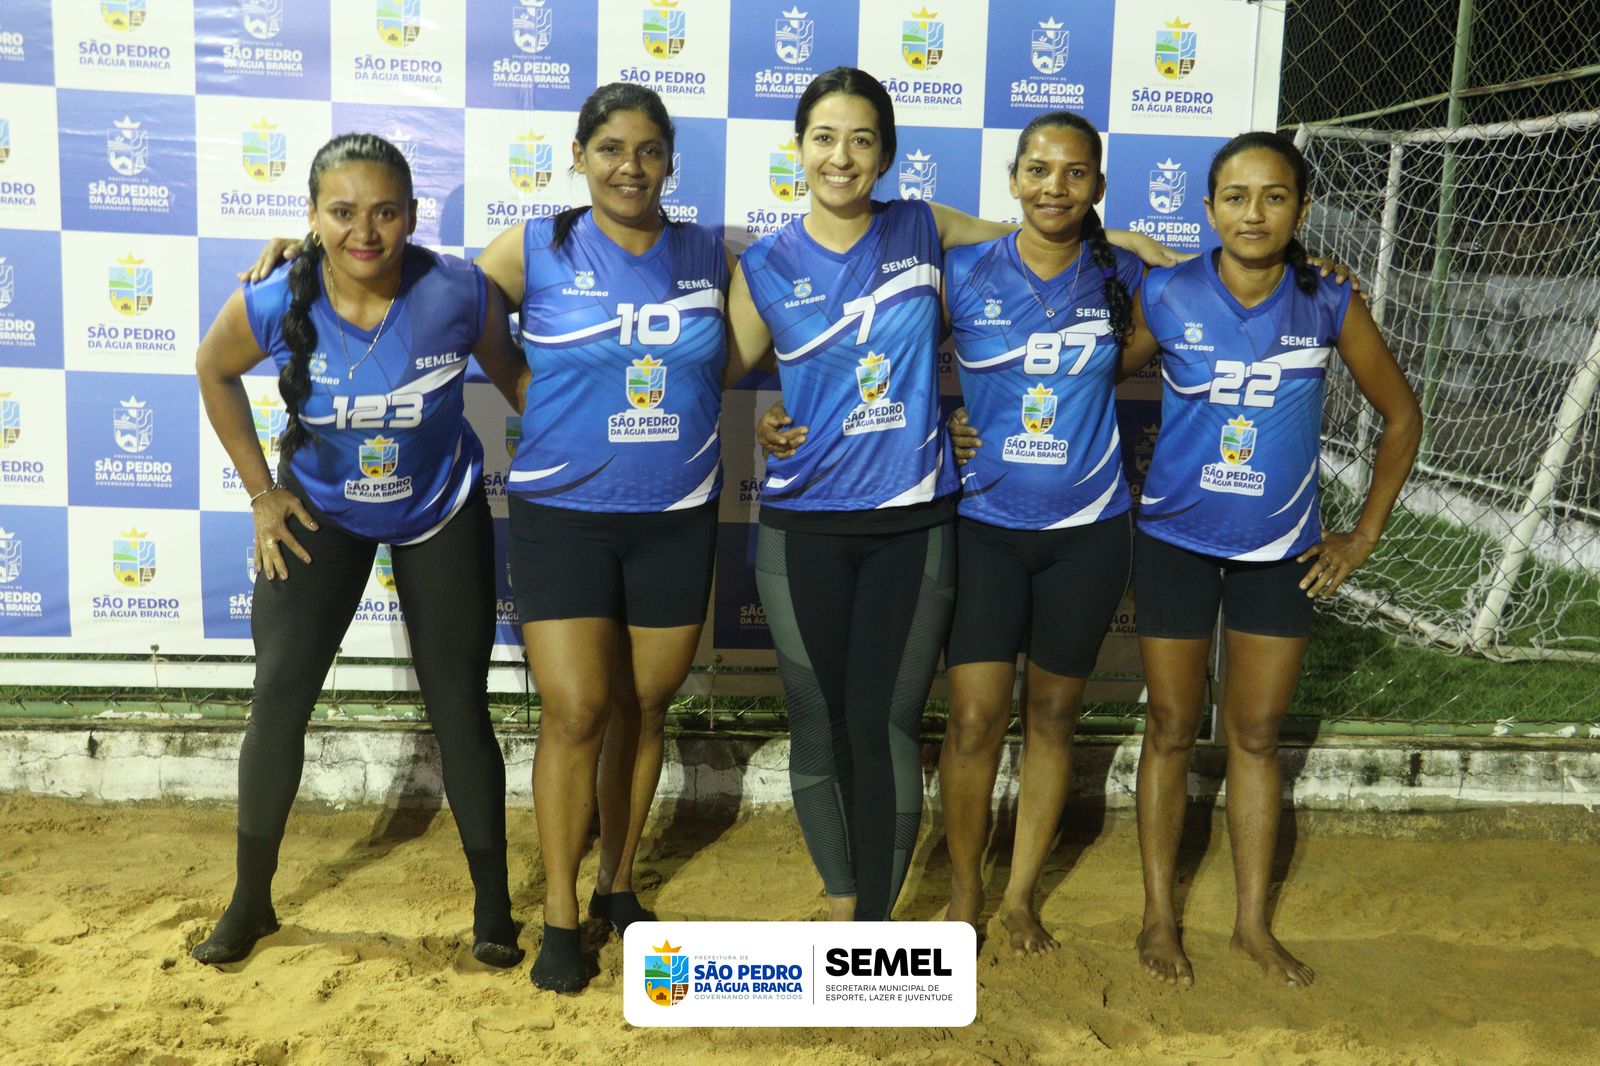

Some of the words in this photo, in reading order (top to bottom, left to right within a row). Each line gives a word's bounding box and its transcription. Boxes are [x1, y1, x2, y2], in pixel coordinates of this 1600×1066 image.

[79, 40, 110, 55] SÃO
[117, 44, 170, 59] PEDRO
[223, 44, 251, 60] SÃO
[255, 49, 303, 62] PEDRO
[80, 56, 94, 65] DA
[97, 56, 126, 67] ÁGUA
[129, 60, 171, 70] BRANCA
[240, 60, 264, 70] ÁGUA
[267, 62, 303, 72] BRANCA
[355, 54, 385, 70] SÃO
[390, 59, 442, 73] PEDRO
[493, 58, 521, 73] SÃO
[527, 63, 570, 75] PEDRO
[355, 72, 368, 81] DA
[372, 71, 399, 82] ÁGUA
[402, 74, 442, 84] BRANCA
[493, 74, 507, 82] DA
[509, 73, 532, 83] ÁGUA
[534, 74, 570, 84] BRANCA
[621, 67, 650, 82] SÃO
[655, 71, 705, 84] PEDRO
[755, 69, 783, 83] SÃO
[667, 85, 705, 94] BRANCA
[755, 84, 768, 92] DA
[770, 83, 793, 93] ÁGUA
[913, 81, 962, 94] PEDRO
[1011, 80, 1039, 94] SÃO
[1043, 82, 1084, 96] PEDRO
[895, 93, 921, 103] ÁGUA
[924, 96, 962, 104] BRANCA
[1025, 94, 1048, 103] ÁGUA
[1050, 96, 1083, 104] BRANCA
[1132, 87, 1161, 102] SÃO
[1165, 91, 1213, 104] PEDRO
[1147, 102, 1172, 112] ÁGUA
[1176, 105, 1212, 113] BRANCA
[89, 180, 118, 196] SÃO
[122, 185, 168, 198] PEDRO
[89, 196, 102, 204] DA
[105, 195, 130, 206] ÁGUA
[132, 197, 168, 207] BRANCA
[221, 189, 252, 205] SÃO
[257, 193, 307, 207] PEDRO
[221, 207, 235, 216] DA
[238, 205, 266, 216] ÁGUA
[269, 208, 308, 218] BRANCA
[488, 201, 517, 216] SÃO
[748, 209, 777, 223] SÃO
[1129, 219, 1155, 232] SÃO
[1158, 222, 1200, 234] PEDRO
[881, 256, 919, 274] SEMEL
[677, 278, 713, 289] SEMEL
[785, 300, 799, 309] SÃO
[801, 294, 826, 305] PEDRO
[616, 303, 681, 345] 10
[843, 294, 876, 346] 7
[974, 318, 987, 326] SÃO
[88, 323, 119, 339] SÃO
[124, 328, 176, 341] PEDRO
[88, 340, 102, 349] DA
[105, 339, 133, 350] ÁGUA
[136, 342, 176, 351] BRANCA
[1280, 335, 1320, 347] SEMEL
[1023, 332, 1096, 375] 87
[1190, 344, 1215, 352] PEDRO
[416, 352, 461, 369] SEMEL
[1209, 360, 1282, 408] 22
[333, 392, 423, 430] 123
[869, 404, 902, 417] PEDRO
[611, 415, 635, 428] SÃO
[639, 415, 677, 427] PEDRO
[856, 419, 874, 427] ÁGUA
[876, 415, 903, 424] BRANCA
[611, 428, 621, 436] DA
[624, 427, 646, 436] ÁGUA
[648, 427, 677, 435] BRANCA
[1007, 438, 1027, 449] SÃO
[1030, 440, 1066, 451] PEDRO
[1016, 448, 1035, 457] ÁGUA
[1038, 450, 1066, 459] BRANCA
[95, 457, 122, 472] SÃO
[127, 461, 172, 474] PEDRO
[4, 475, 44, 483] BRANCA
[96, 472, 109, 480] DA
[110, 471, 134, 481] ÁGUA
[137, 473, 172, 482] BRANCA
[1204, 465, 1223, 478] SÃO
[1226, 471, 1264, 483] PEDRO
[223, 481, 236, 489] DA
[347, 482, 369, 491] SÃO
[373, 478, 410, 491] PEDRO
[1203, 475, 1211, 483] DA
[1212, 477, 1232, 488] ÁGUA
[1234, 480, 1263, 491] BRANCA
[383, 486, 410, 497] BRANCA
[6, 604, 41, 612] BRANCA
[93, 595, 124, 609] SÃO
[128, 597, 179, 609] PEDRO
[94, 610, 107, 618] DA
[110, 608, 138, 618] ÁGUA
[140, 610, 180, 619] BRANCA
[372, 612, 398, 621] ÁGUA
